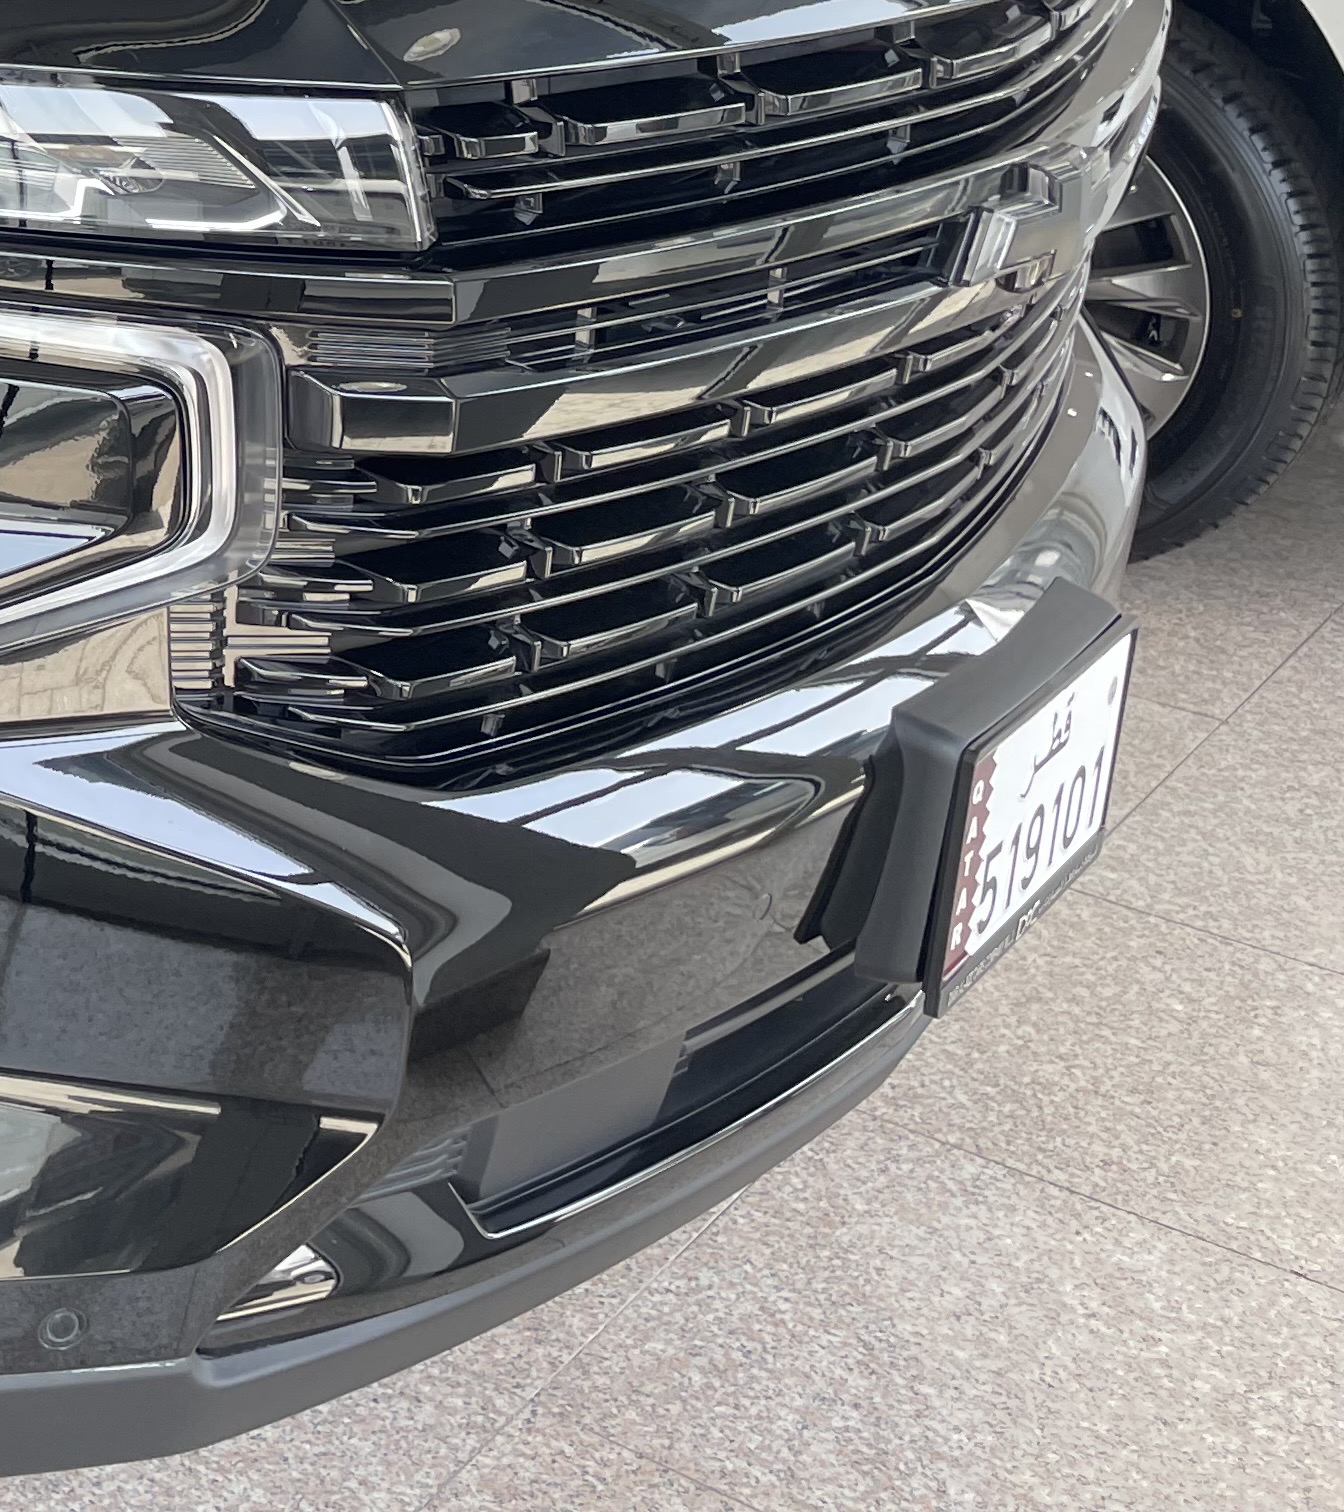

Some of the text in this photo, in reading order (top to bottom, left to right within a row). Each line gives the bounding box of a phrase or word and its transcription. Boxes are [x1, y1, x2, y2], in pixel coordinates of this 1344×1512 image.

[1019, 692, 1075, 799] قطر
[950, 779, 984, 952] QATAR
[978, 745, 1105, 935] 519101
